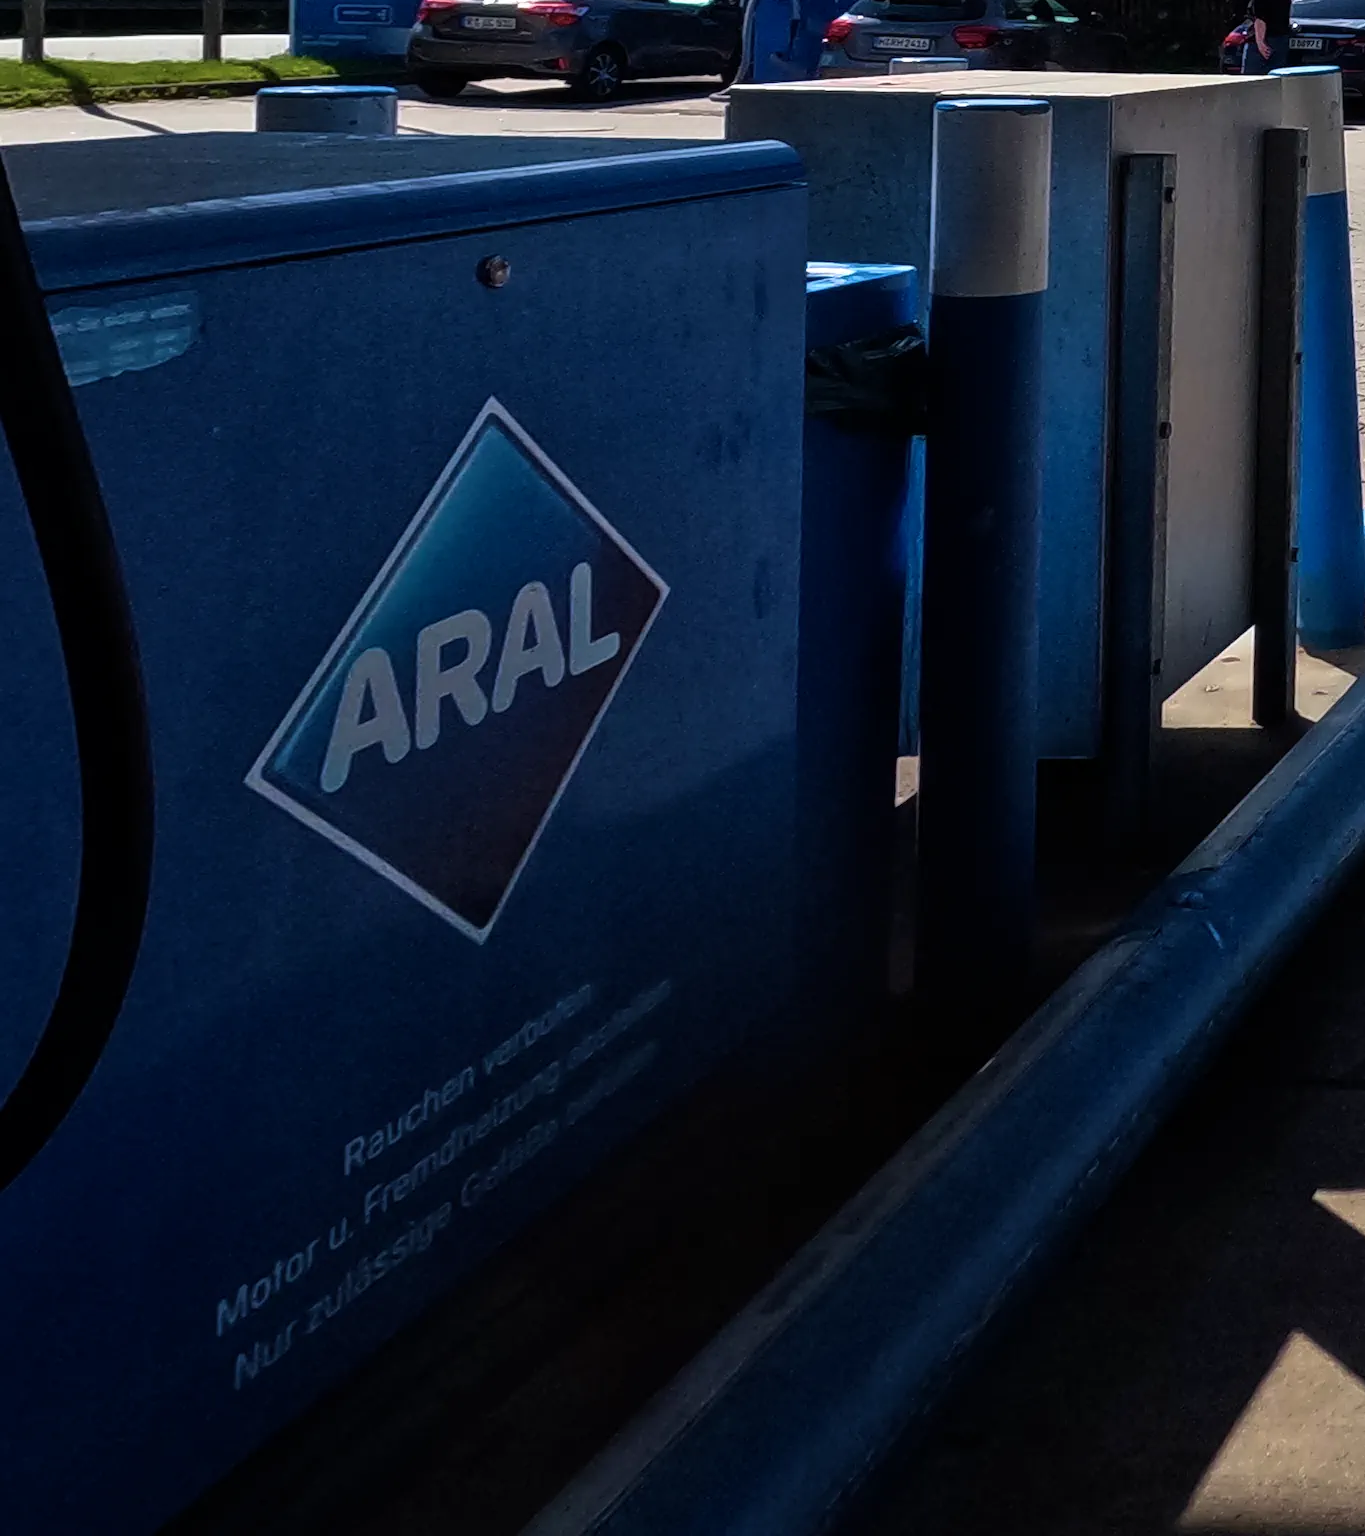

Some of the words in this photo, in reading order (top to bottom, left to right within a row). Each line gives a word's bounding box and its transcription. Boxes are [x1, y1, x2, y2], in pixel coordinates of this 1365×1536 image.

[319, 561, 621, 795] ARAL
[342, 1064, 476, 1176] Rauchen
[215, 1235, 320, 1337] Motor
[327, 1214, 354, 1253] u.
[231, 1320, 298, 1392] Nur
